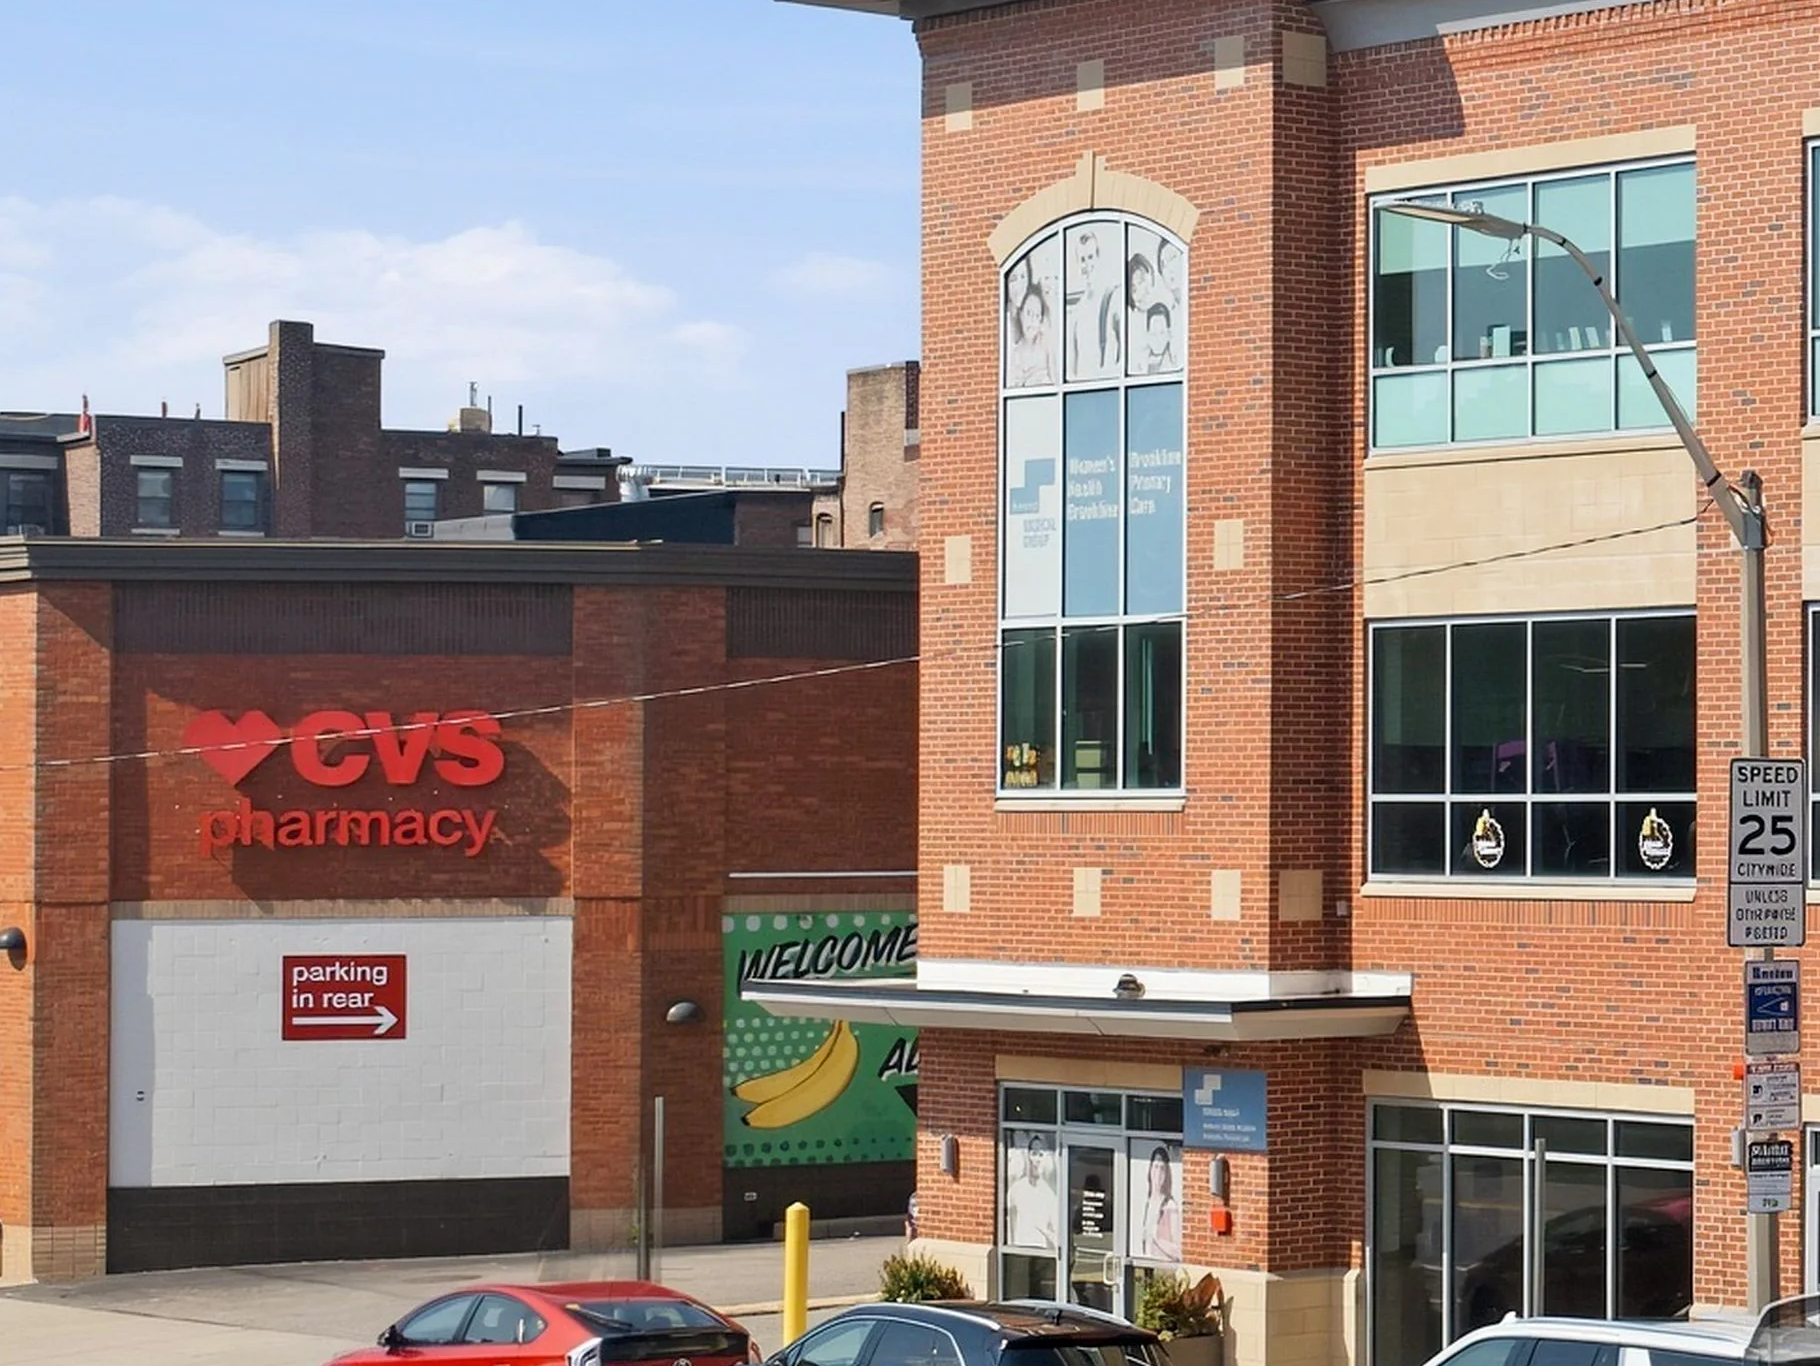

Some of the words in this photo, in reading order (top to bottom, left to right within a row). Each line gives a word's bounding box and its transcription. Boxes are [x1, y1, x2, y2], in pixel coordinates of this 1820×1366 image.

[291, 710, 505, 787] CVS
[1737, 766, 1798, 784] SPEED
[1743, 790, 1791, 807] LIMIT
[200, 798, 498, 857] pharmacy
[1738, 814, 1796, 856] 25
[292, 962, 387, 985] parking
[292, 989, 313, 1008] in
[322, 992, 374, 1008] rear
